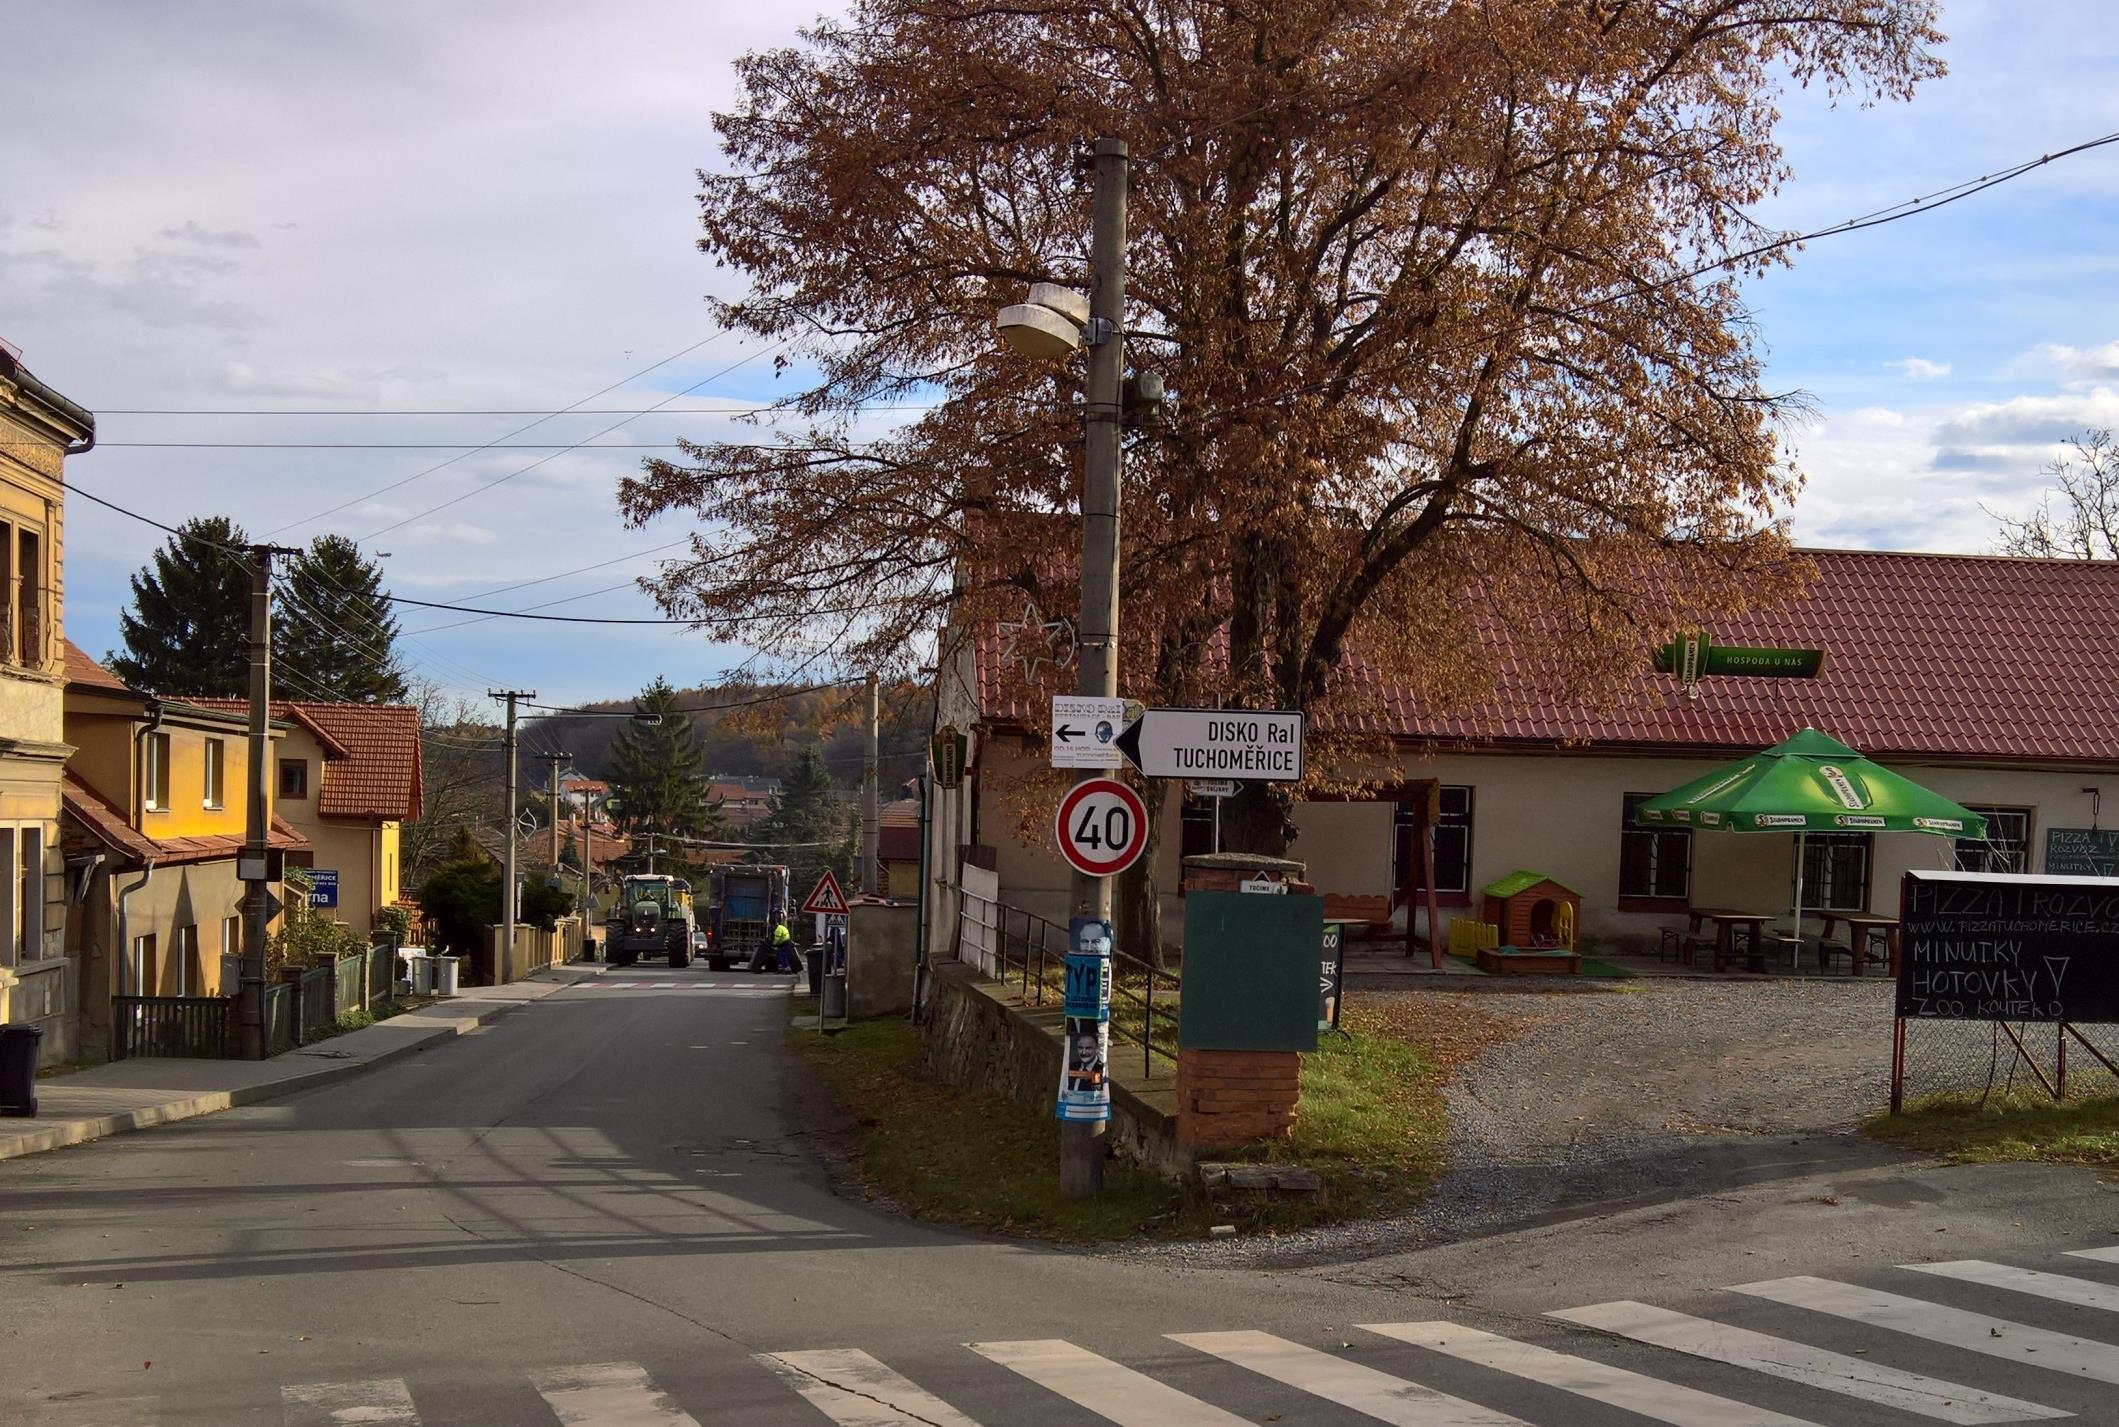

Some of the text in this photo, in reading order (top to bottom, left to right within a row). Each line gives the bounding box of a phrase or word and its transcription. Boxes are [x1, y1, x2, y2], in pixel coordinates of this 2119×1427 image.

[1726, 656, 1771, 665] HOSPODA
[1774, 657, 1781, 666] U
[1208, 721, 1258, 743] DISKO
[1173, 744, 1294, 771] TUCHOMĚŘICE
[1074, 805, 1129, 851] 40
[2052, 831, 2091, 844] PIZZA
[1910, 884, 2003, 917] PIZZA
[1914, 940, 2022, 967] MINUTKY
[1321, 961, 1337, 976] TEK
[1912, 970, 2037, 1001] HOTOVKY
[1912, 997, 2044, 1018] ZOO KOUTEK
